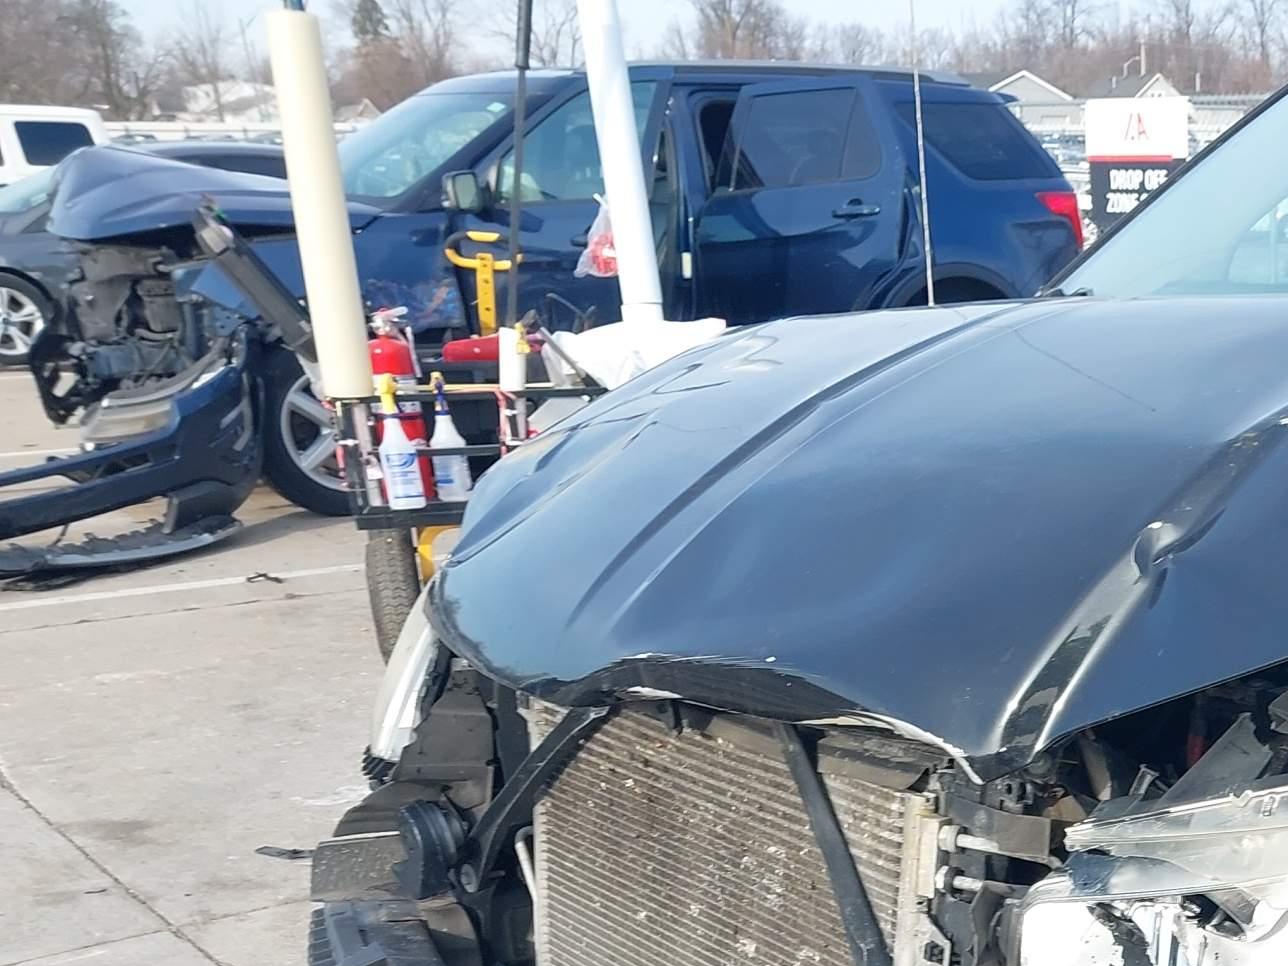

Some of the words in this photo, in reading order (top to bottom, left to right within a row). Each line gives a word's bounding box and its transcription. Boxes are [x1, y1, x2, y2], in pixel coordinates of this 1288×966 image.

[1109, 168, 1143, 190] DROP
[1144, 168, 1169, 190] OFF
[1106, 192, 1139, 213] ZONE
